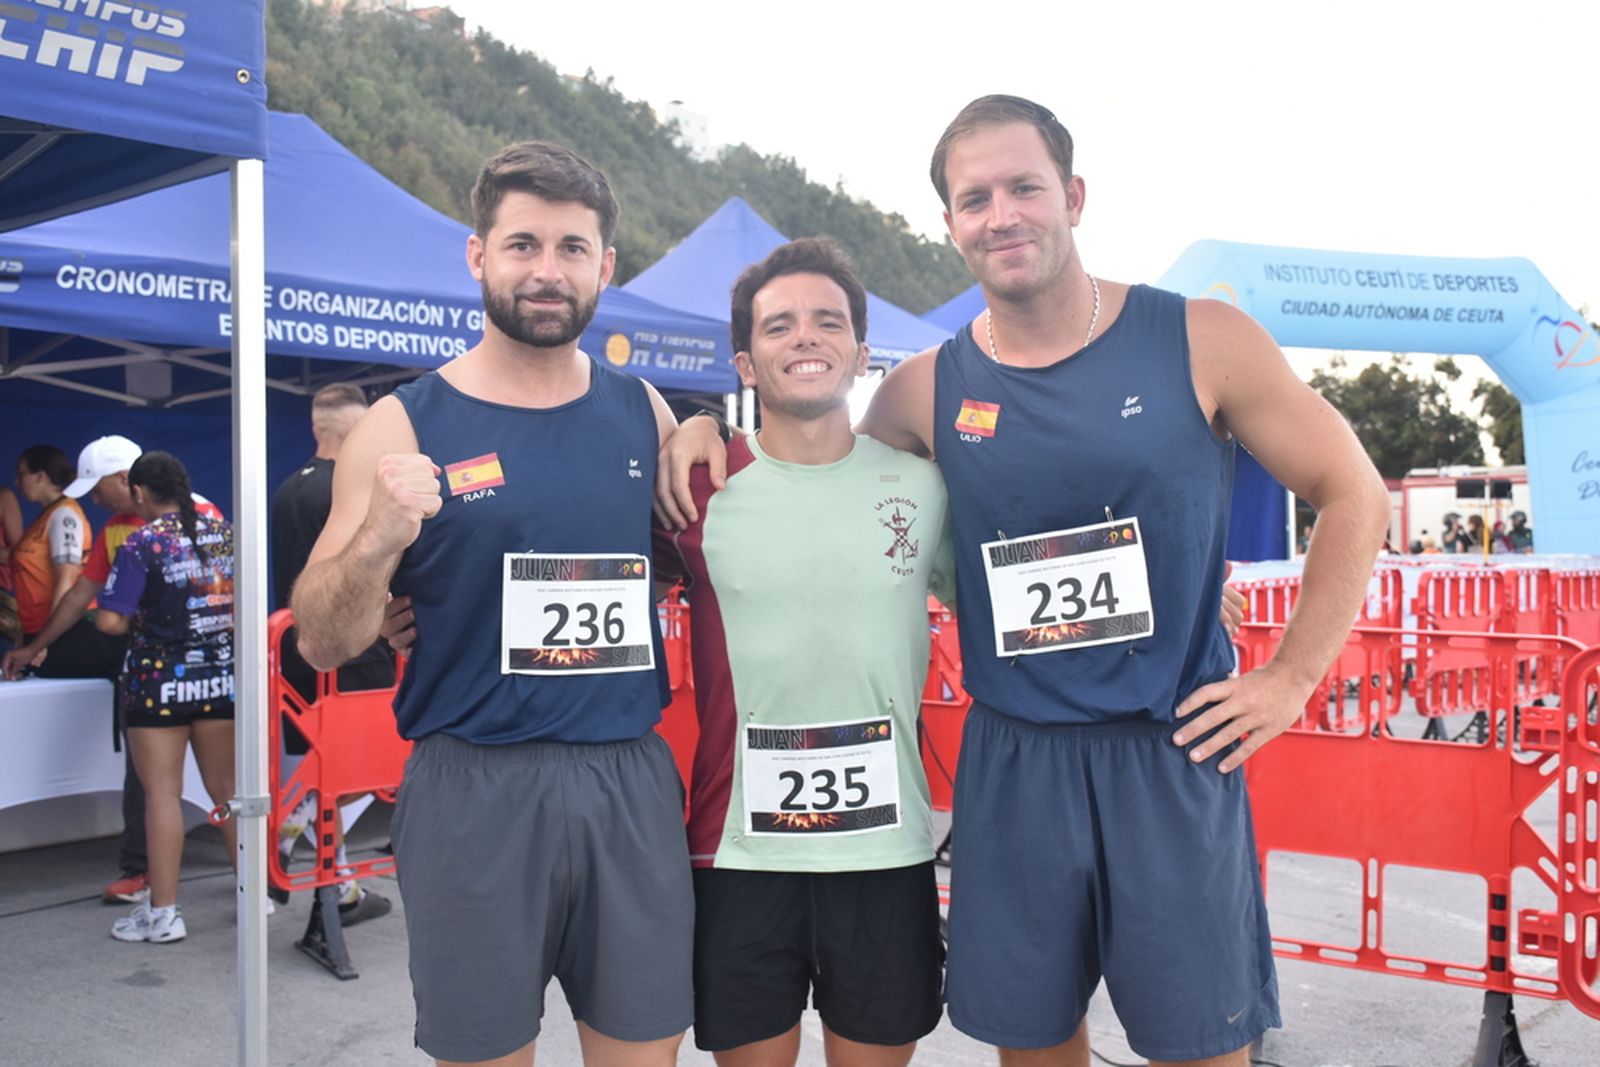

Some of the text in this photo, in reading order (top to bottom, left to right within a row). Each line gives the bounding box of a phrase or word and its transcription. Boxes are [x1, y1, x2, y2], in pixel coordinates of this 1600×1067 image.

[1263, 264, 1350, 286] INSTITUTO
[1407, 272, 1432, 290] DE
[1433, 273, 1520, 293] DEPORTES
[279, 287, 445, 328] ORGANIZACIÓN
[448, 307, 463, 329] Y
[1280, 300, 1505, 324] CIUDAD AUTÓNOMA DE CEUTA
[333, 325, 468, 359] DEPORTIVOS
[462, 488, 497, 503] RAFA
[874, 502, 885, 511] LA
[989, 538, 1051, 568] JUAN
[511, 558, 576, 581] JUAN
[1026, 571, 1119, 626] 234
[542, 601, 625, 646] 236
[748, 728, 808, 750] JUAN
[778, 765, 870, 811] 235
